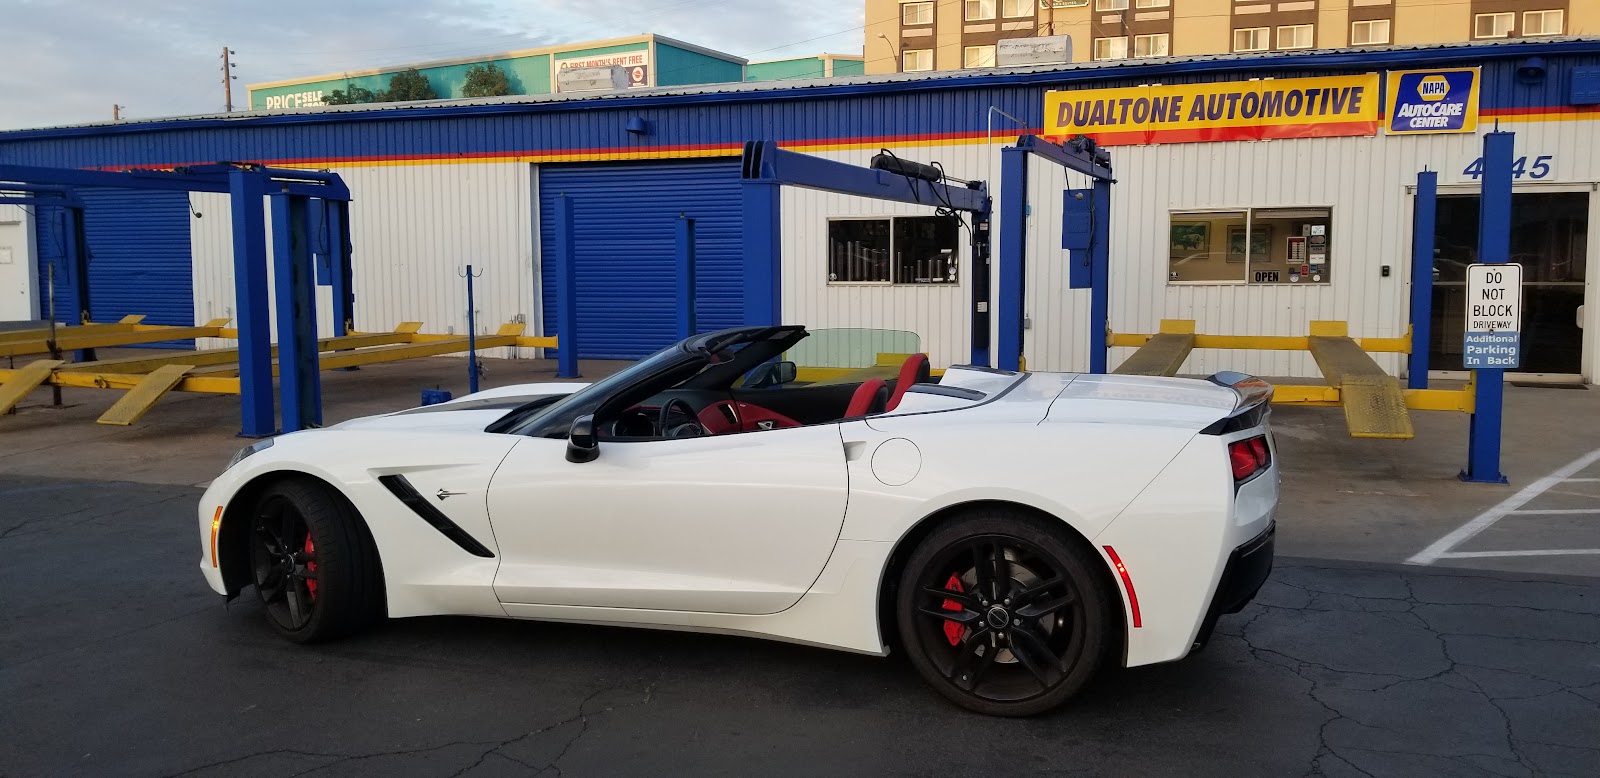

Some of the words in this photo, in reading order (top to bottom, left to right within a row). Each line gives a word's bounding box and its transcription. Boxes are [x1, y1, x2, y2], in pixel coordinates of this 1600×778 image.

[613, 57, 627, 65] RENT
[629, 55, 643, 64] FREE
[1422, 82, 1445, 94] NAPA
[266, 93, 302, 109] PRICE
[302, 90, 322, 102] SELF
[1056, 95, 1183, 127] DUALTONE
[1188, 86, 1364, 121] AUTOMOTIVE
[1409, 117, 1449, 128] CENTER
[1463, 155, 1552, 179] 445
[1255, 271, 1279, 282] OPEN
[1486, 272, 1502, 284] DO
[1482, 288, 1505, 300] NOT
[1473, 304, 1513, 317] BLOCK
[1473, 320, 1512, 329] DRIVEWAY
[1466, 335, 1517, 343] Additional
[1466, 345, 1516, 356] Parking
[1467, 356, 1480, 365] In
[1487, 356, 1515, 365] Back
